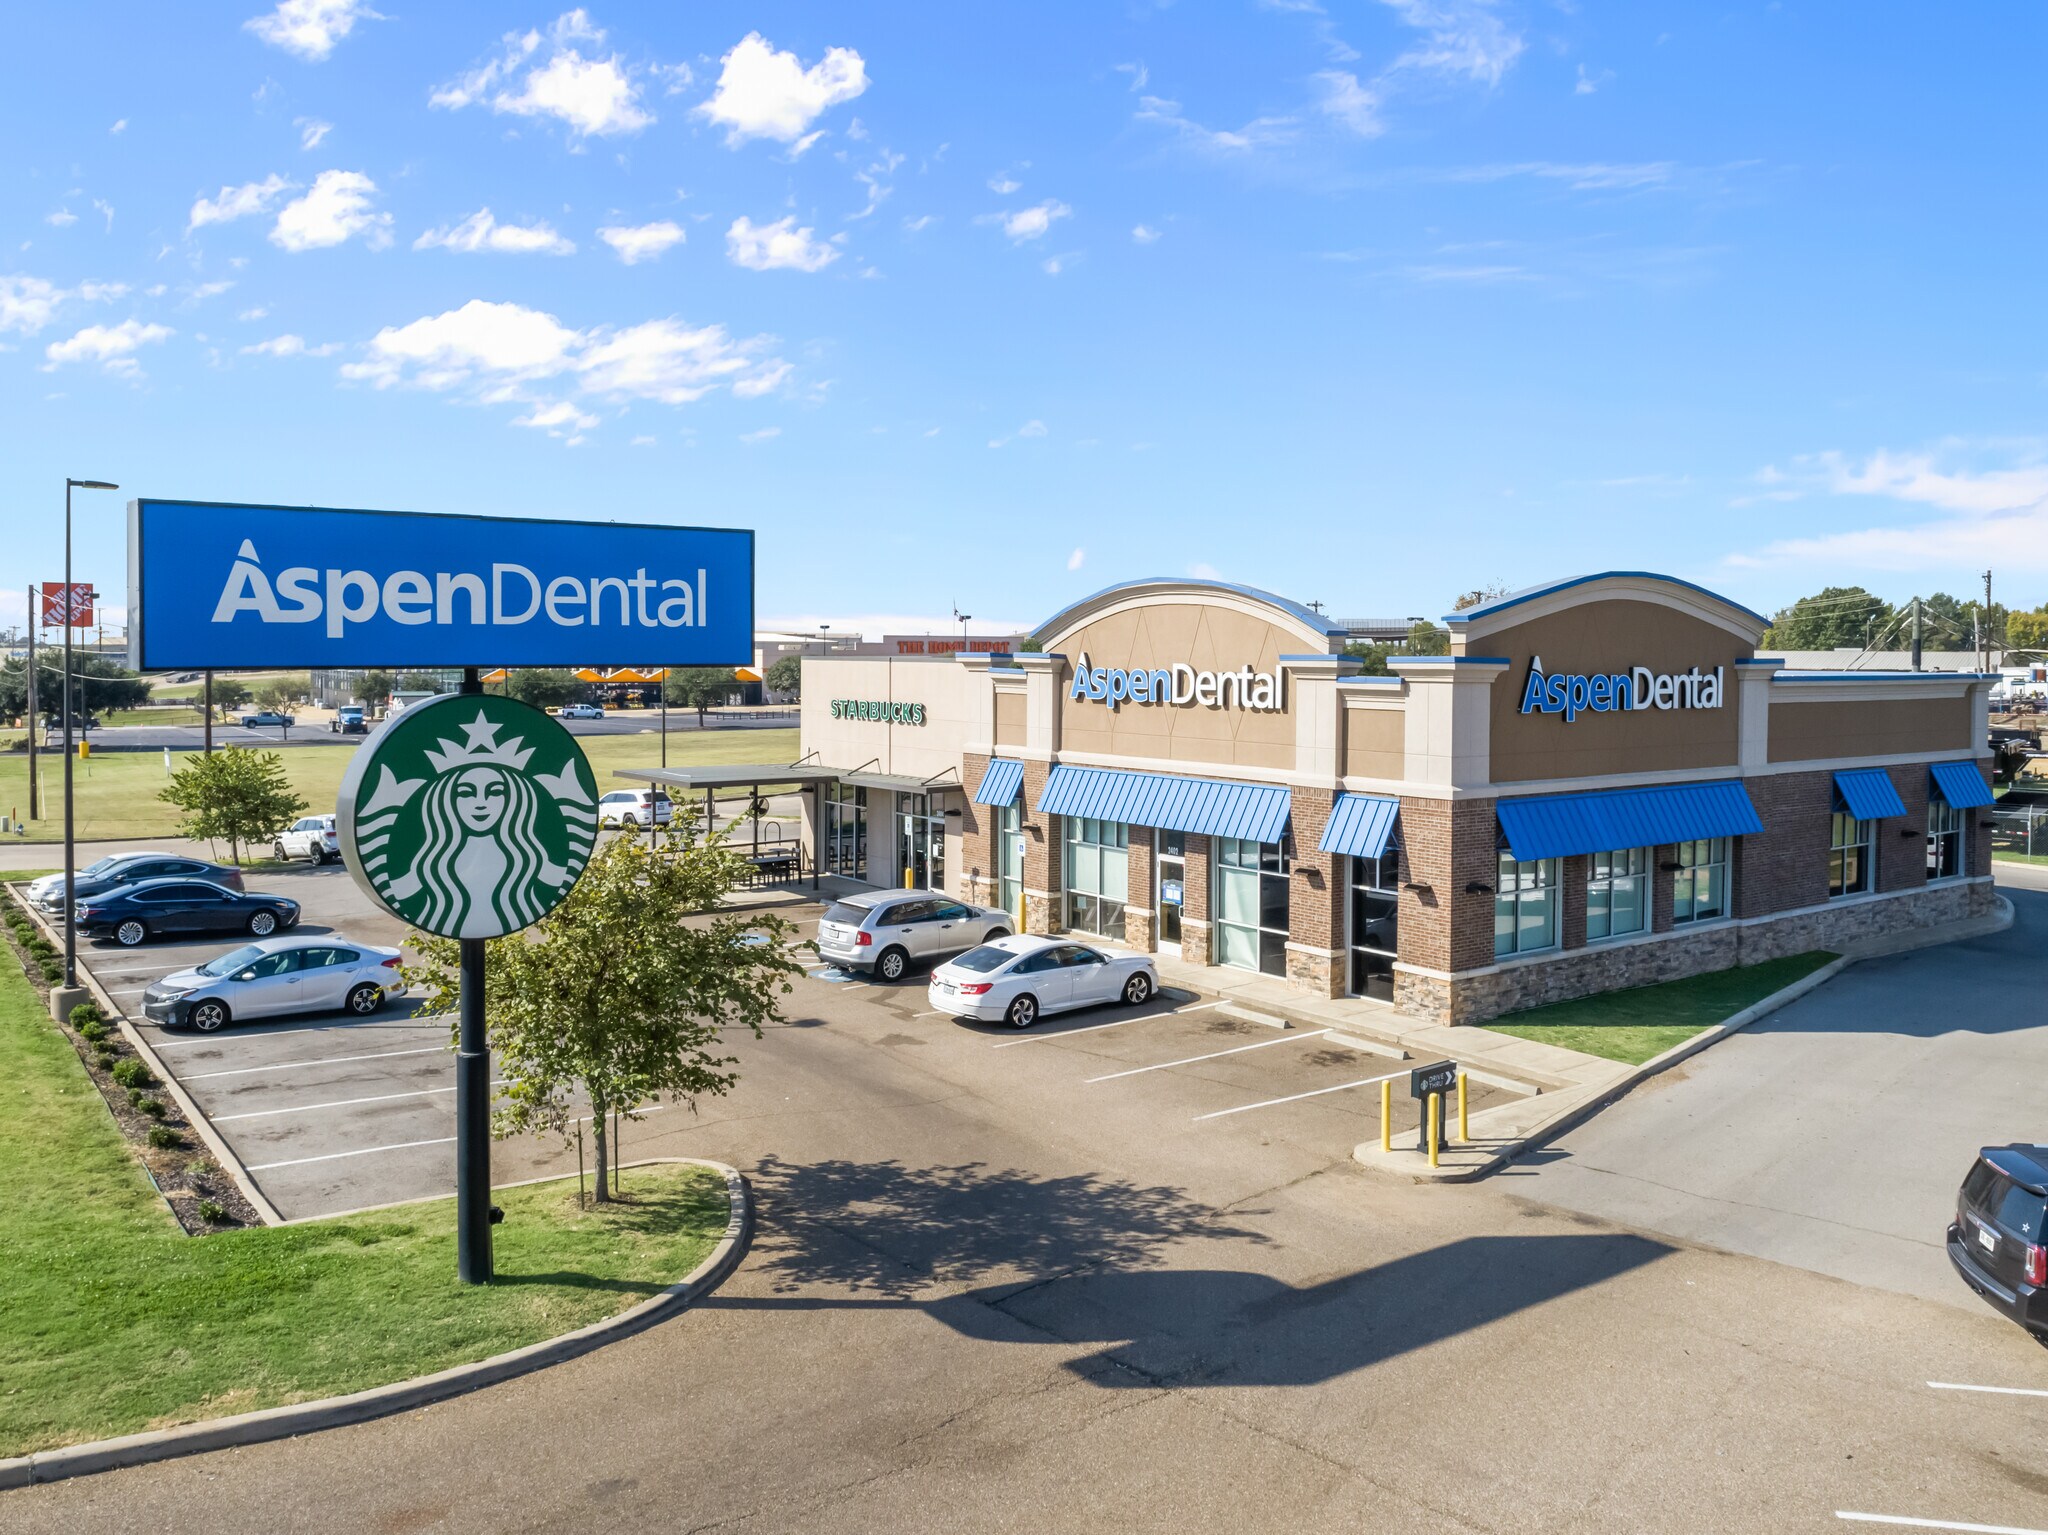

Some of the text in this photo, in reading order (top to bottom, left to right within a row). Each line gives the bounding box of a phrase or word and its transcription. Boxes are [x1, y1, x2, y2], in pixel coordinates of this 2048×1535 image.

[211, 538, 707, 638] AspenDental
[897, 641, 1010, 654] THE HOME DEPOT
[1070, 651, 1282, 710] AspenDental
[1520, 655, 1724, 723] AspenDental
[830, 699, 922, 724] STARBUCKS
[1428, 1072, 1444, 1083] DRIVE
[1429, 1080, 1444, 1089] THRU
